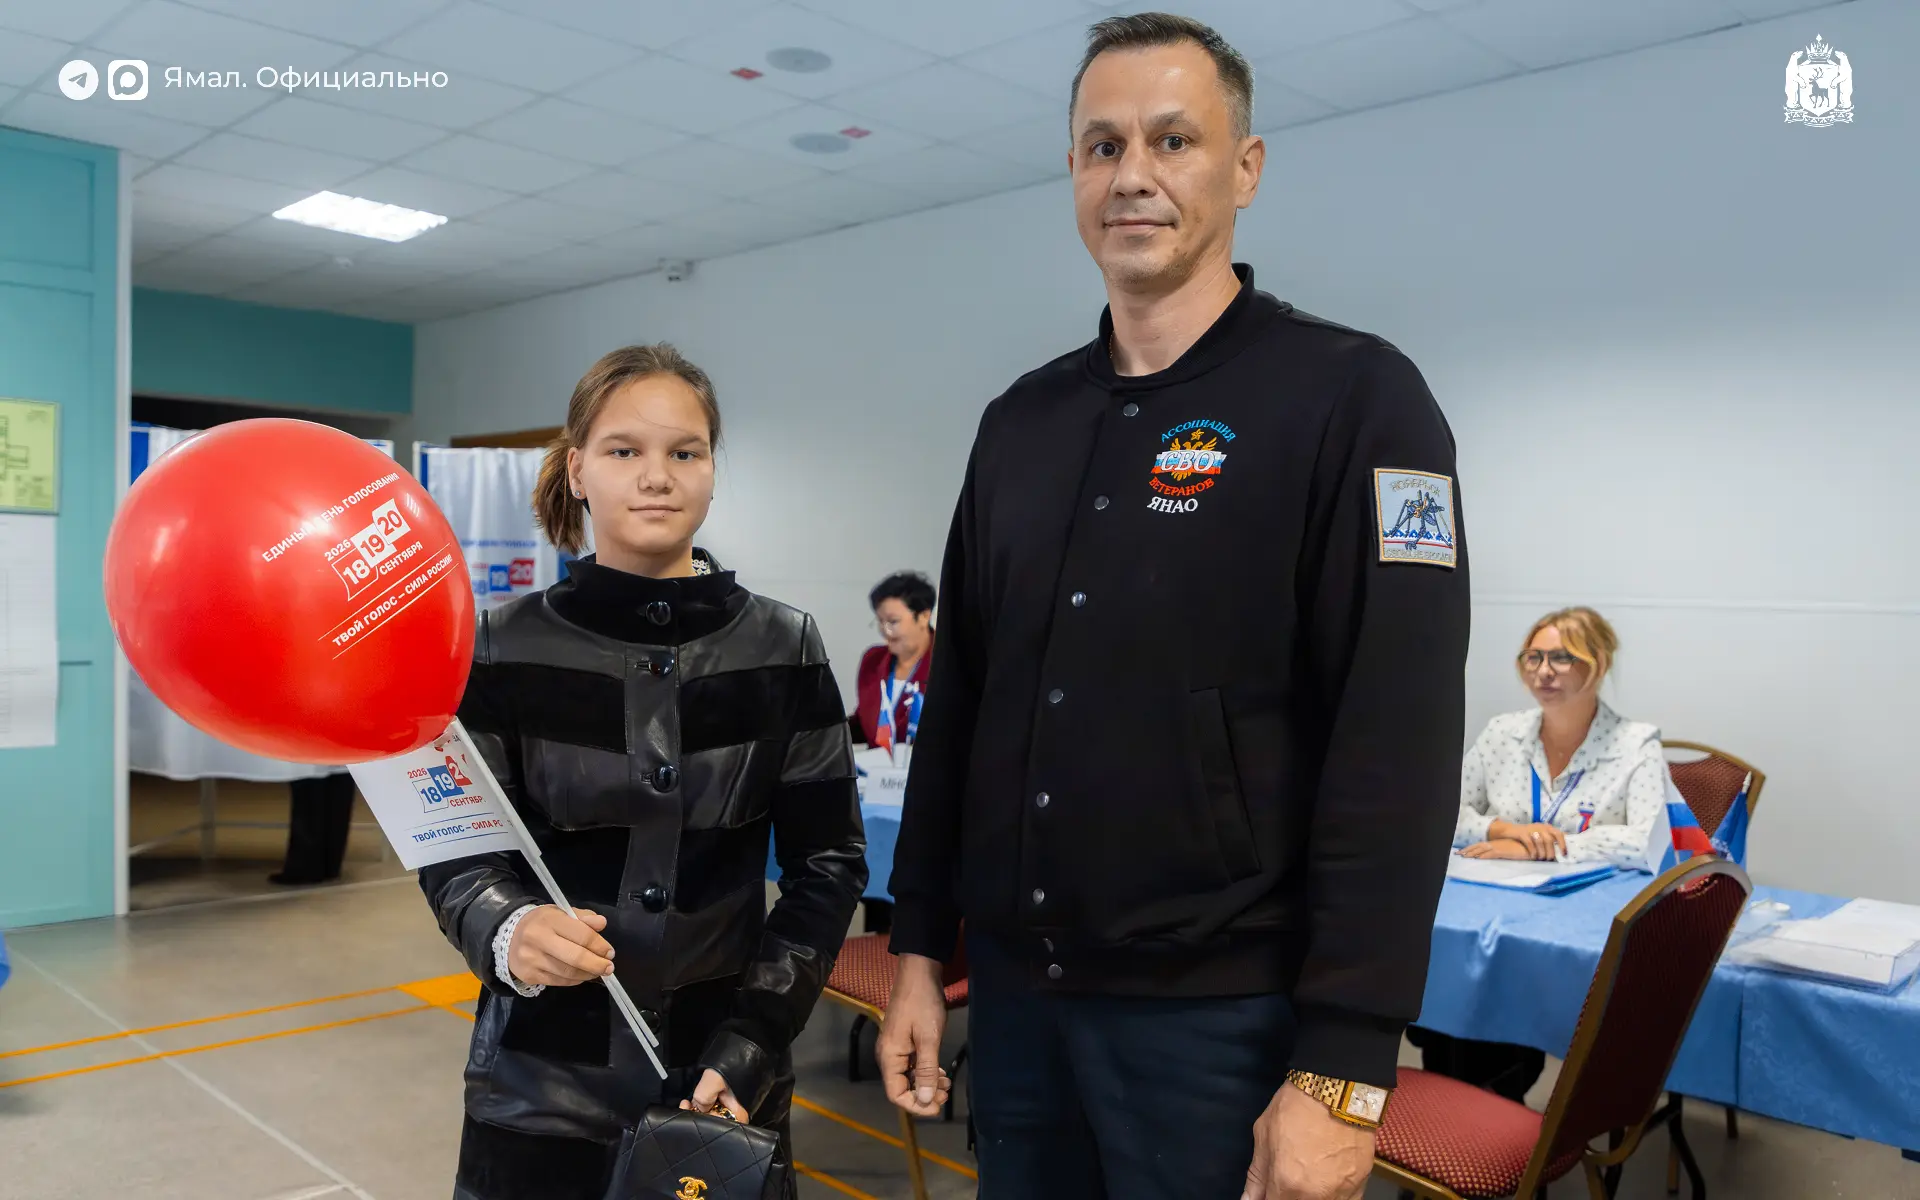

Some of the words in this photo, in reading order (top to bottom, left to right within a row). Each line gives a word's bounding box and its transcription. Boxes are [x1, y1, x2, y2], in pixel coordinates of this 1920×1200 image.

[1161, 419, 1236, 442] АССОЦИАЦИЯ
[1160, 450, 1216, 472] СВО
[1149, 476, 1215, 497] ВЕТЕРАНОВ
[262, 520, 317, 562] ЕДИНЫ
[313, 505, 345, 532] ЕНЬ
[342, 472, 400, 509] ГОЛОСОВАНИЯ
[1146, 496, 1199, 514] ЯНАО
[324, 538, 352, 562] 2026
[342, 558, 371, 585] 18
[360, 534, 386, 558] 19
[377, 509, 403, 537] 20
[378, 540, 424, 575] СЕНТЯБРЯ
[332, 620, 365, 647] ТВОЙ
[363, 596, 398, 625] ГОЛОС
[404, 573, 429, 595] СИЛА
[407, 767, 428, 780] 2026
[420, 786, 443, 805] 18
[434, 772, 455, 792] 19
[450, 795, 486, 808] СЕНТЯБР
[412, 829, 438, 844] ТВОЙ
[436, 824, 465, 840] ГОЛОС
[471, 819, 494, 831] СИЛА
